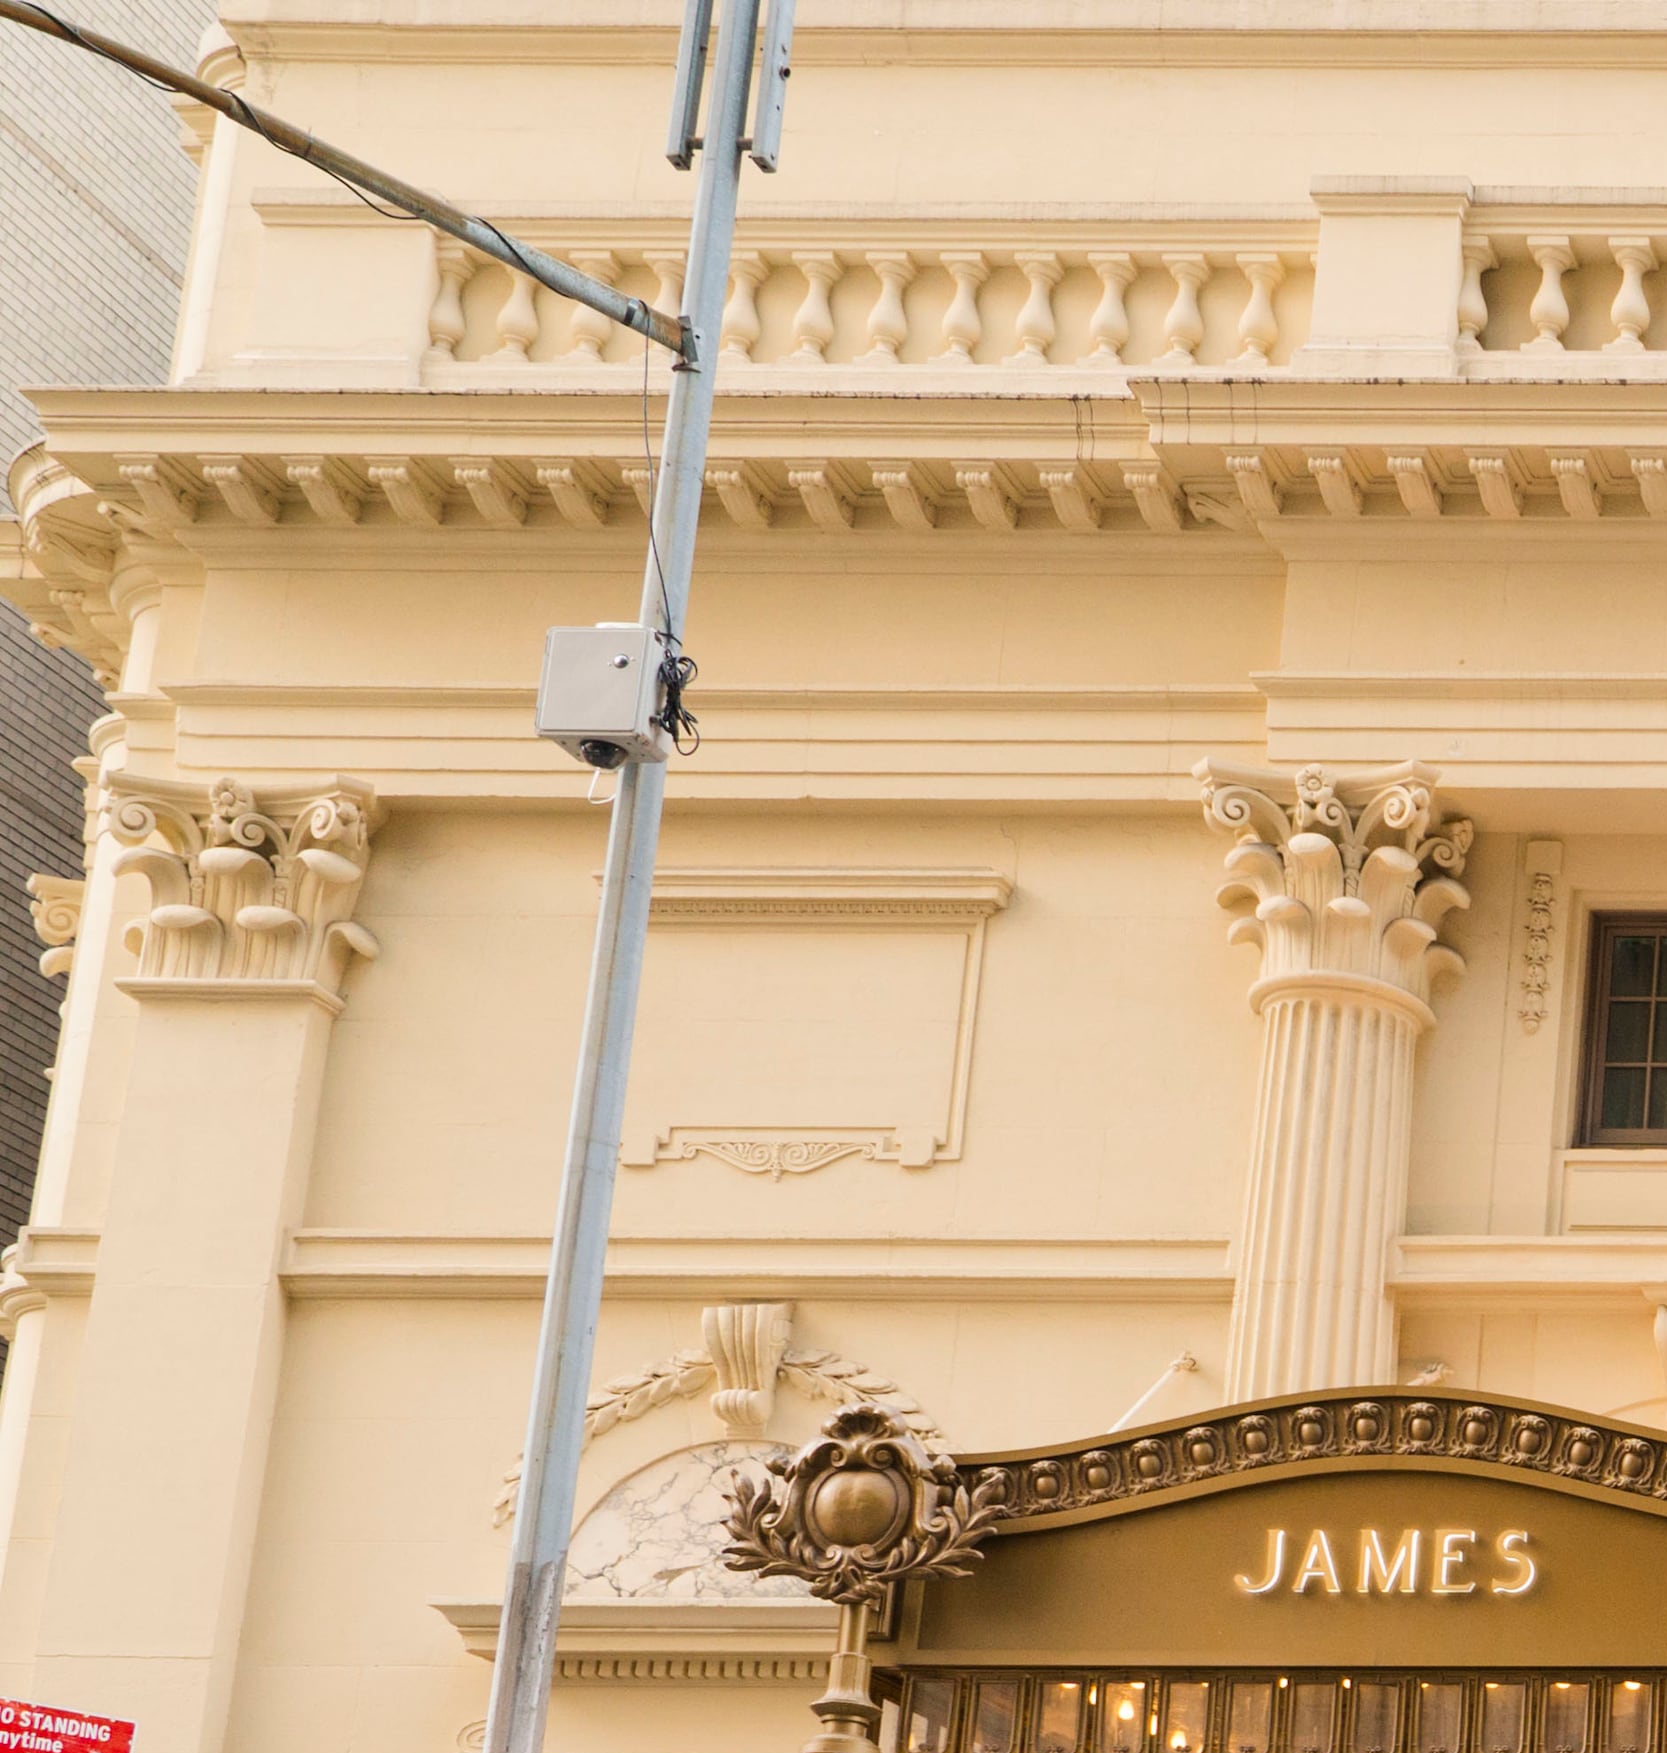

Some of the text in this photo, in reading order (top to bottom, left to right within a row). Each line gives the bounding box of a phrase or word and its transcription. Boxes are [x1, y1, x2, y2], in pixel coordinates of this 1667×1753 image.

[1233, 1529, 1537, 1593] JAMES
[19, 1710, 111, 1741] STANDING
[0, 1730, 63, 1753] nytime
